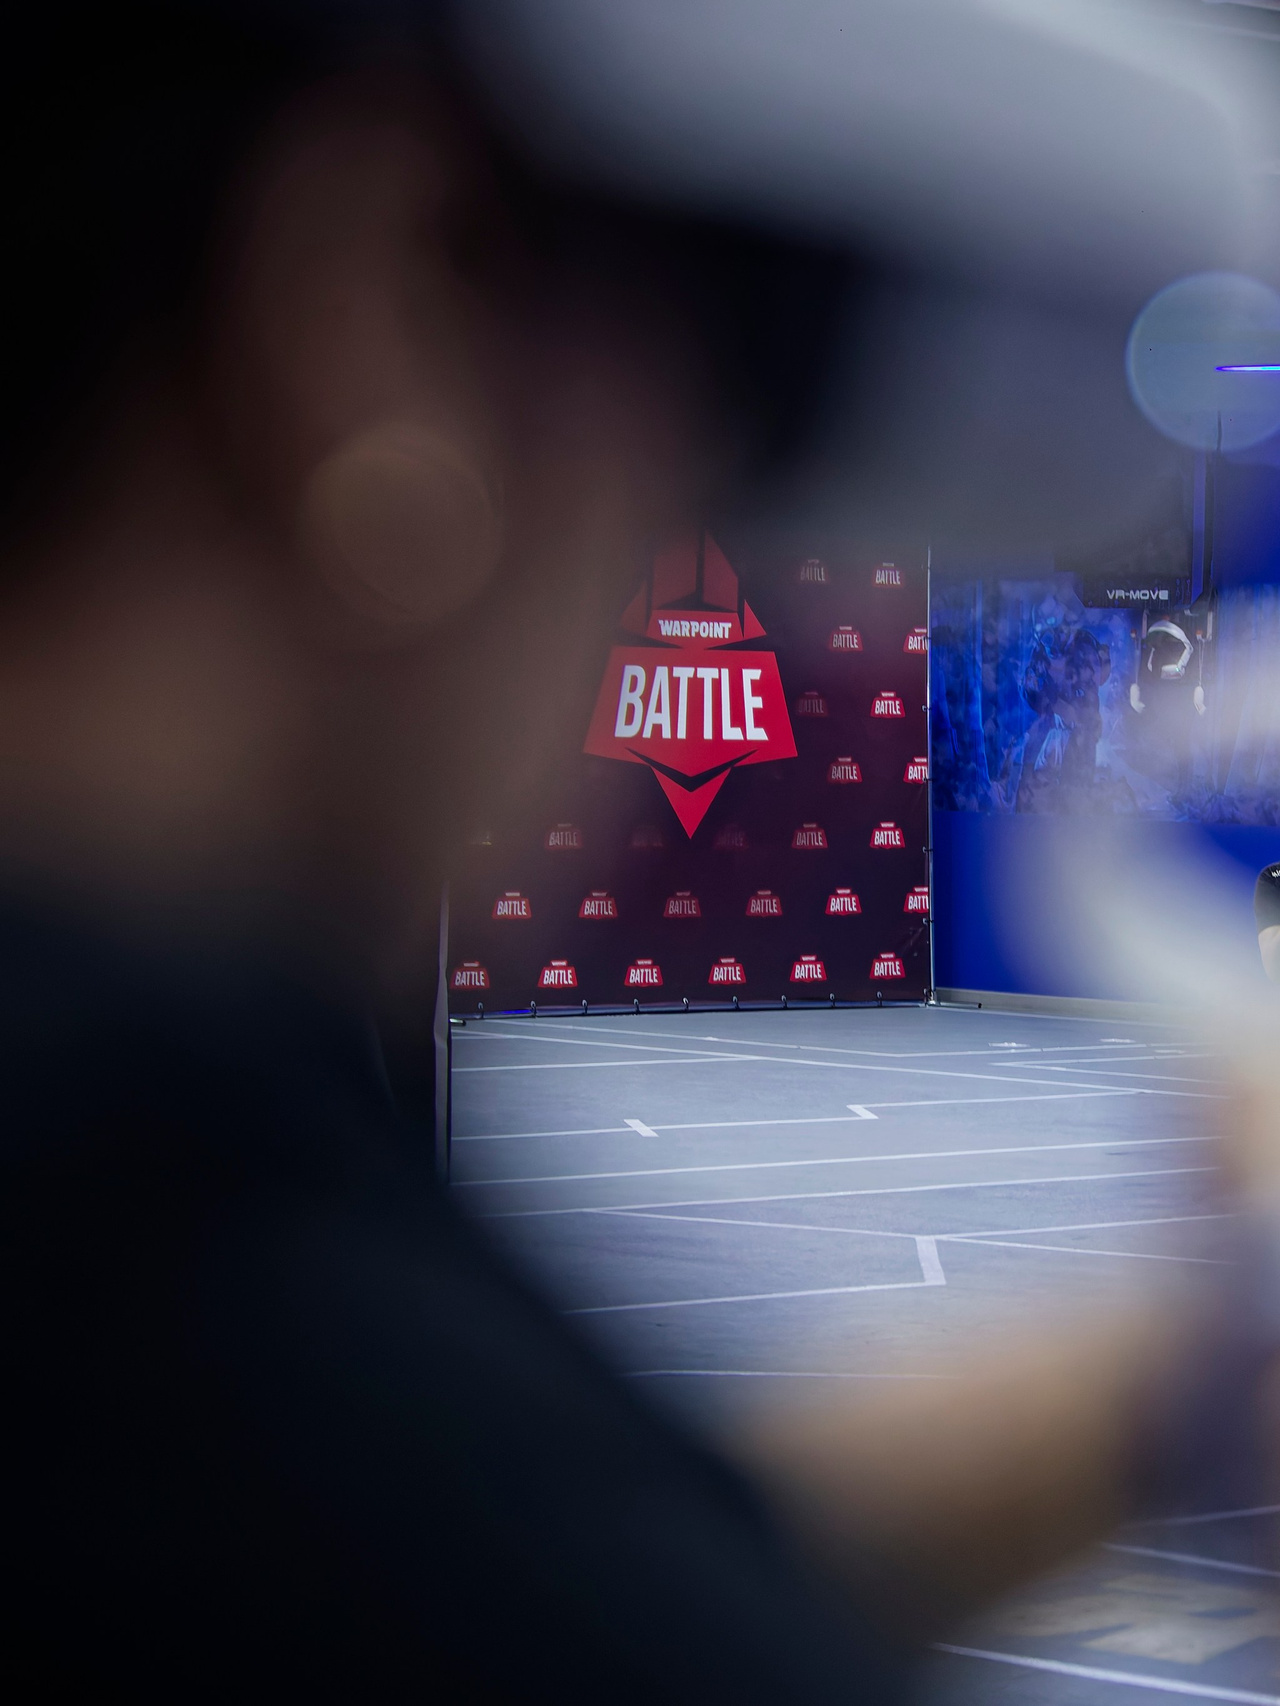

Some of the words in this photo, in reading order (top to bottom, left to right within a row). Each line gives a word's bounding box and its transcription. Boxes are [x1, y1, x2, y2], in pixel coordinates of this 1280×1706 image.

[875, 569, 901, 585] BATTLE
[658, 619, 732, 639] WARPOINT
[832, 633, 859, 649] BATTLE
[614, 664, 769, 741] BATTLE
[874, 700, 901, 715] BATTLE
[831, 765, 858, 780] BATTLE
[796, 831, 823, 846] BATTLE
[874, 830, 901, 845] BATTLE
[497, 900, 527, 916] BATTLE
[584, 900, 613, 916] BATTLE
[668, 900, 697, 915] BATTLE
[750, 898, 778, 913] BATTLE
[830, 897, 857, 912] BATTLE
[543, 969, 574, 985] BATTLE
[629, 968, 658, 984] BATTLE
[713, 966, 741, 981] BATTLE
[794, 964, 822, 979] BATTLE
[874, 961, 901, 977] BATTLE
[454, 969, 485, 986] BATTLE
